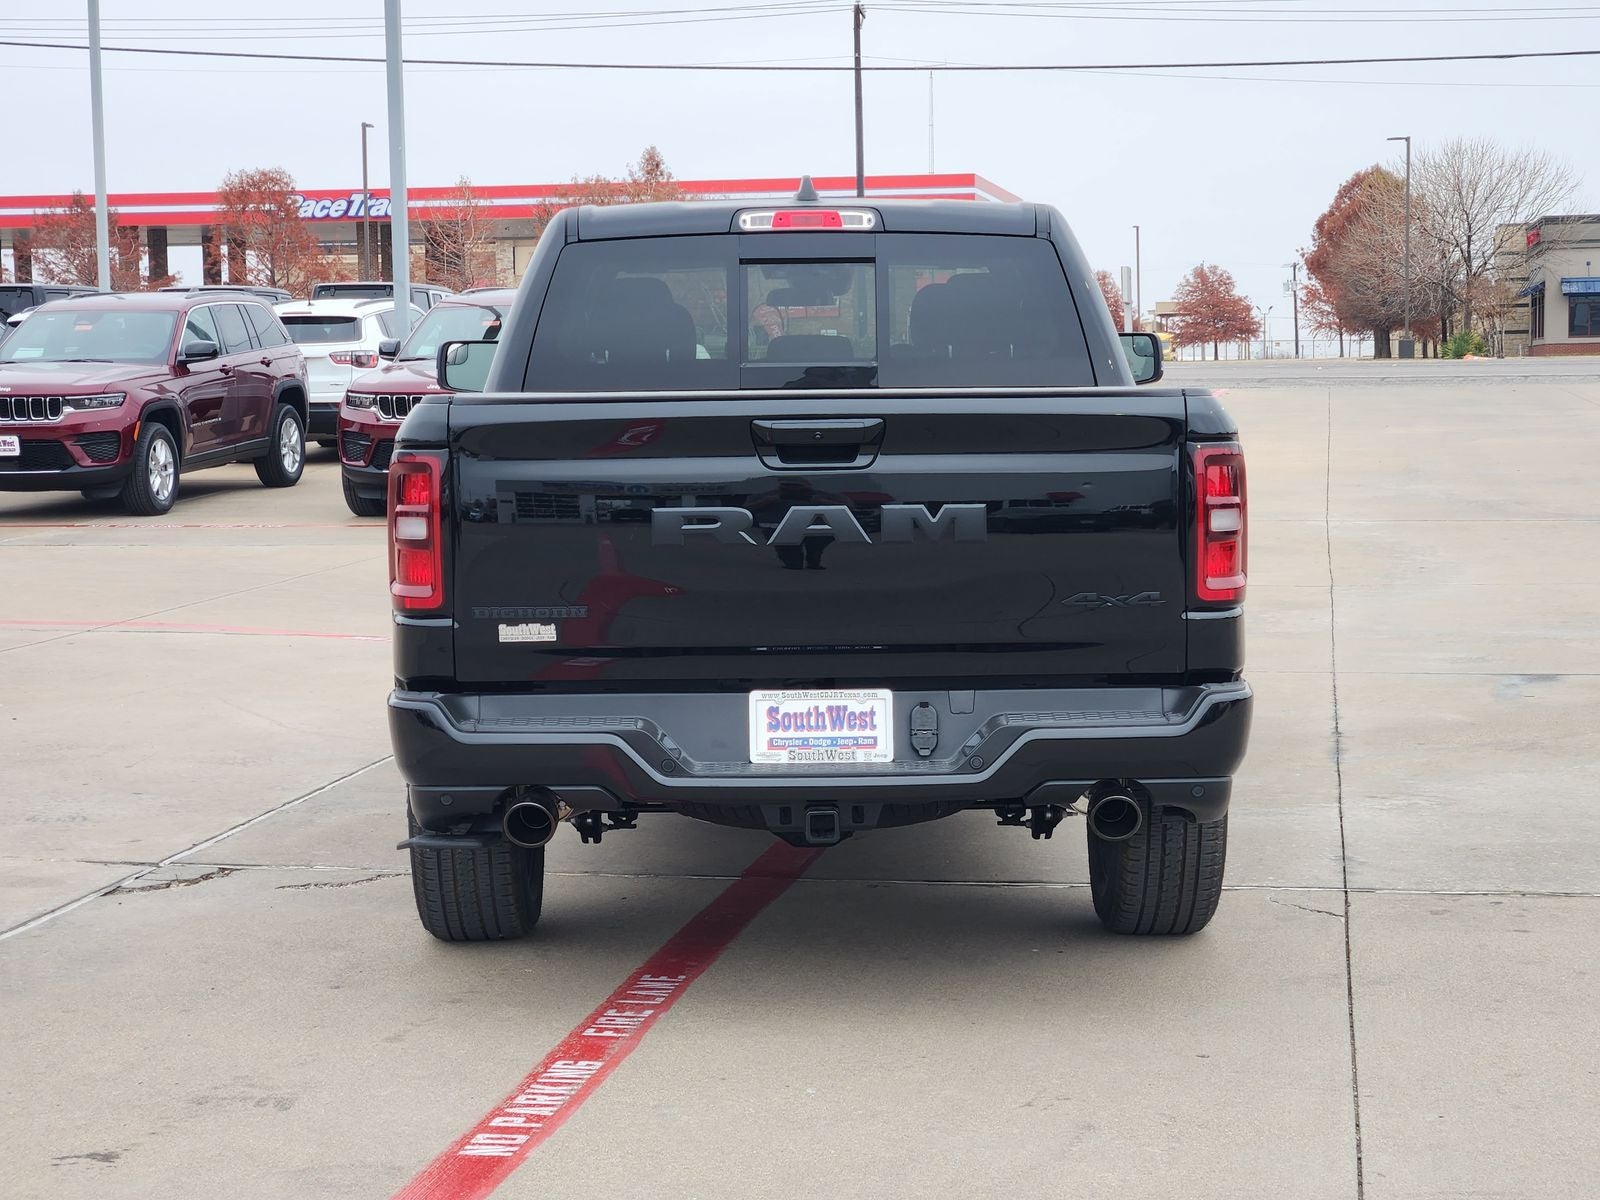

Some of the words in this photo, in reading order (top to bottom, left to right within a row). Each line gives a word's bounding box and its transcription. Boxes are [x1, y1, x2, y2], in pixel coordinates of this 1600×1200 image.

[652, 503, 987, 545] RAM
[1061, 592, 1167, 607] 4x4
[767, 705, 877, 732] SouthWest
[772, 738, 803, 746] Chrysler
[809, 738, 831, 746] Dodge
[837, 737, 854, 745] Jeep
[858, 737, 875, 745] Ram
[788, 749, 857, 761] SouthWest
[615, 974, 686, 1004] LANE
[581, 1009, 654, 1037] FIRE
[488, 1060, 605, 1128] PARKING
[458, 1133, 530, 1157] NO
